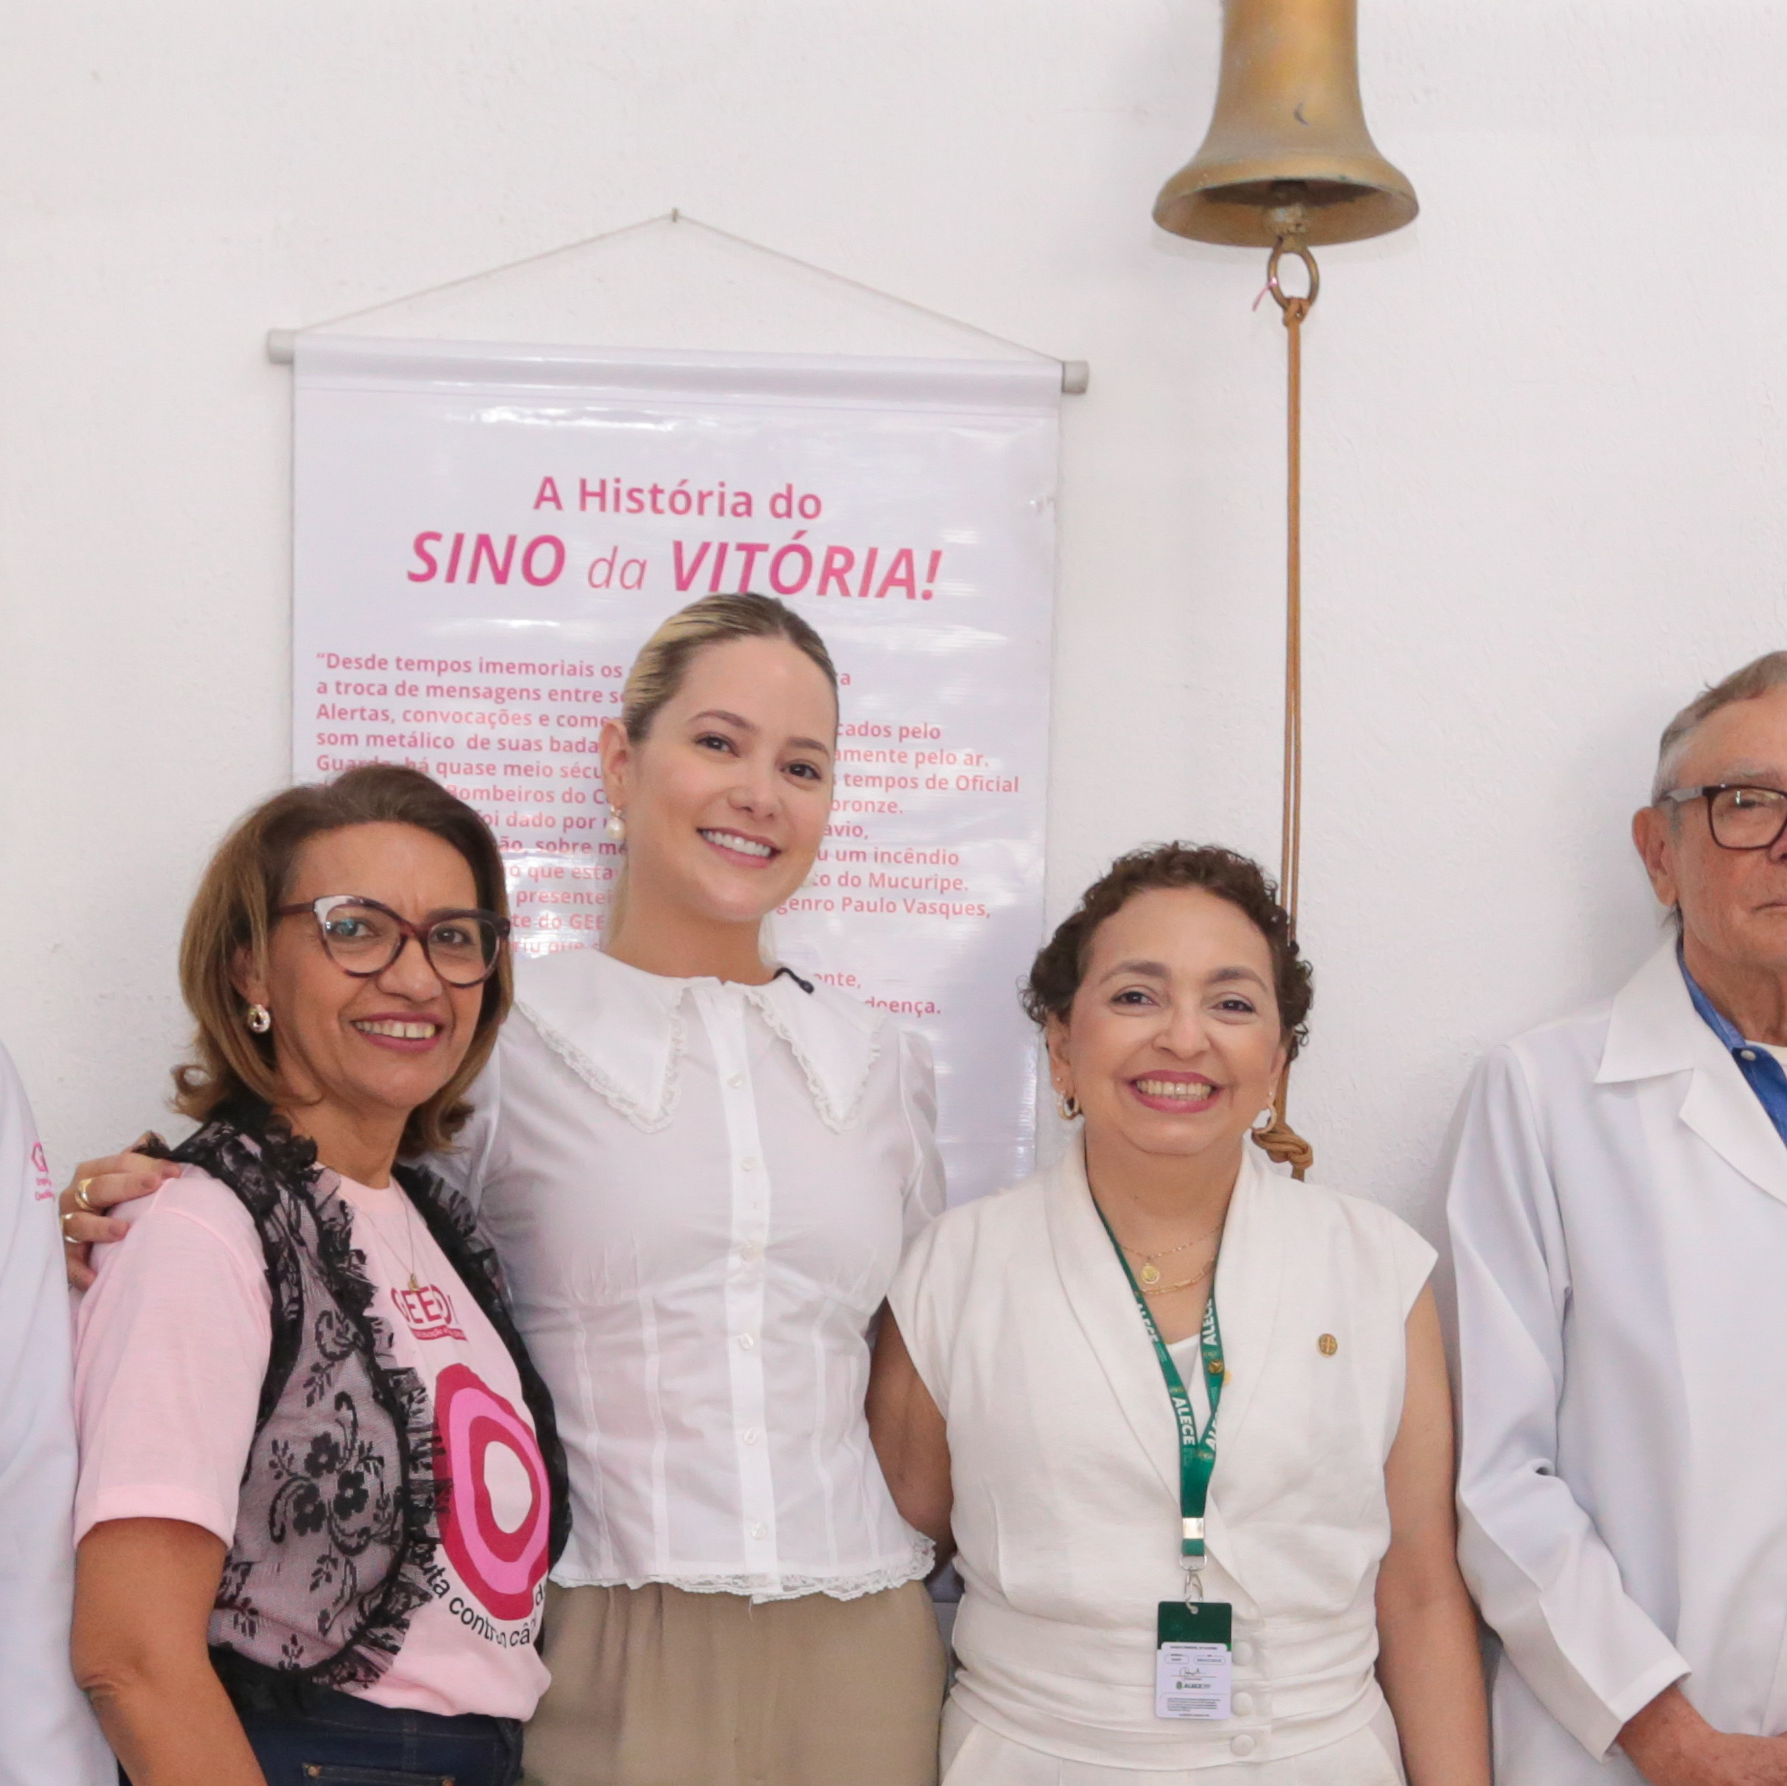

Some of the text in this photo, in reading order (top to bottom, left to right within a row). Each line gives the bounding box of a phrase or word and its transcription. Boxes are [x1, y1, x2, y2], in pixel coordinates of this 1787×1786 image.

[532, 475, 823, 520] A História do
[406, 528, 944, 601] SINO da VITÓRIA!
[394, 654, 473, 677] tempos
[478, 656, 595, 678] imemoriais
[600, 664, 623, 679] os
[316, 681, 328, 695] a
[334, 679, 389, 697] troca
[394, 679, 420, 698] de
[425, 683, 542, 705] mensagens
[547, 687, 604, 704] entre
[315, 702, 396, 725] Alertas,
[402, 708, 533, 730] convocações
[538, 713, 550, 727] e
[898, 722, 942, 743] pelo
[316, 731, 360, 748] som
[365, 730, 456, 750] metálico
[466, 733, 492, 751] de
[496, 737, 544, 752] suas
[914, 748, 958, 769] pelo
[962, 751, 990, 768] ar.
[435, 760, 497, 779] quase
[502, 761, 554, 778] meio
[843, 772, 920, 793] tempos
[924, 773, 950, 791] de
[954, 774, 1020, 794] Oficial
[561, 787, 586, 805] do
[505, 811, 557, 829] dado
[563, 815, 596, 834] por
[535, 837, 592, 855] sobre
[834, 849, 868, 864] um
[873, 846, 960, 867] incêndio
[527, 866, 565, 883] que
[836, 870, 863, 888] do
[868, 871, 970, 895] Mucuripe.
[841, 896, 898, 914] Paulo
[902, 898, 992, 920] Vasques,
[1171, 1396, 1197, 1446] ALECE
